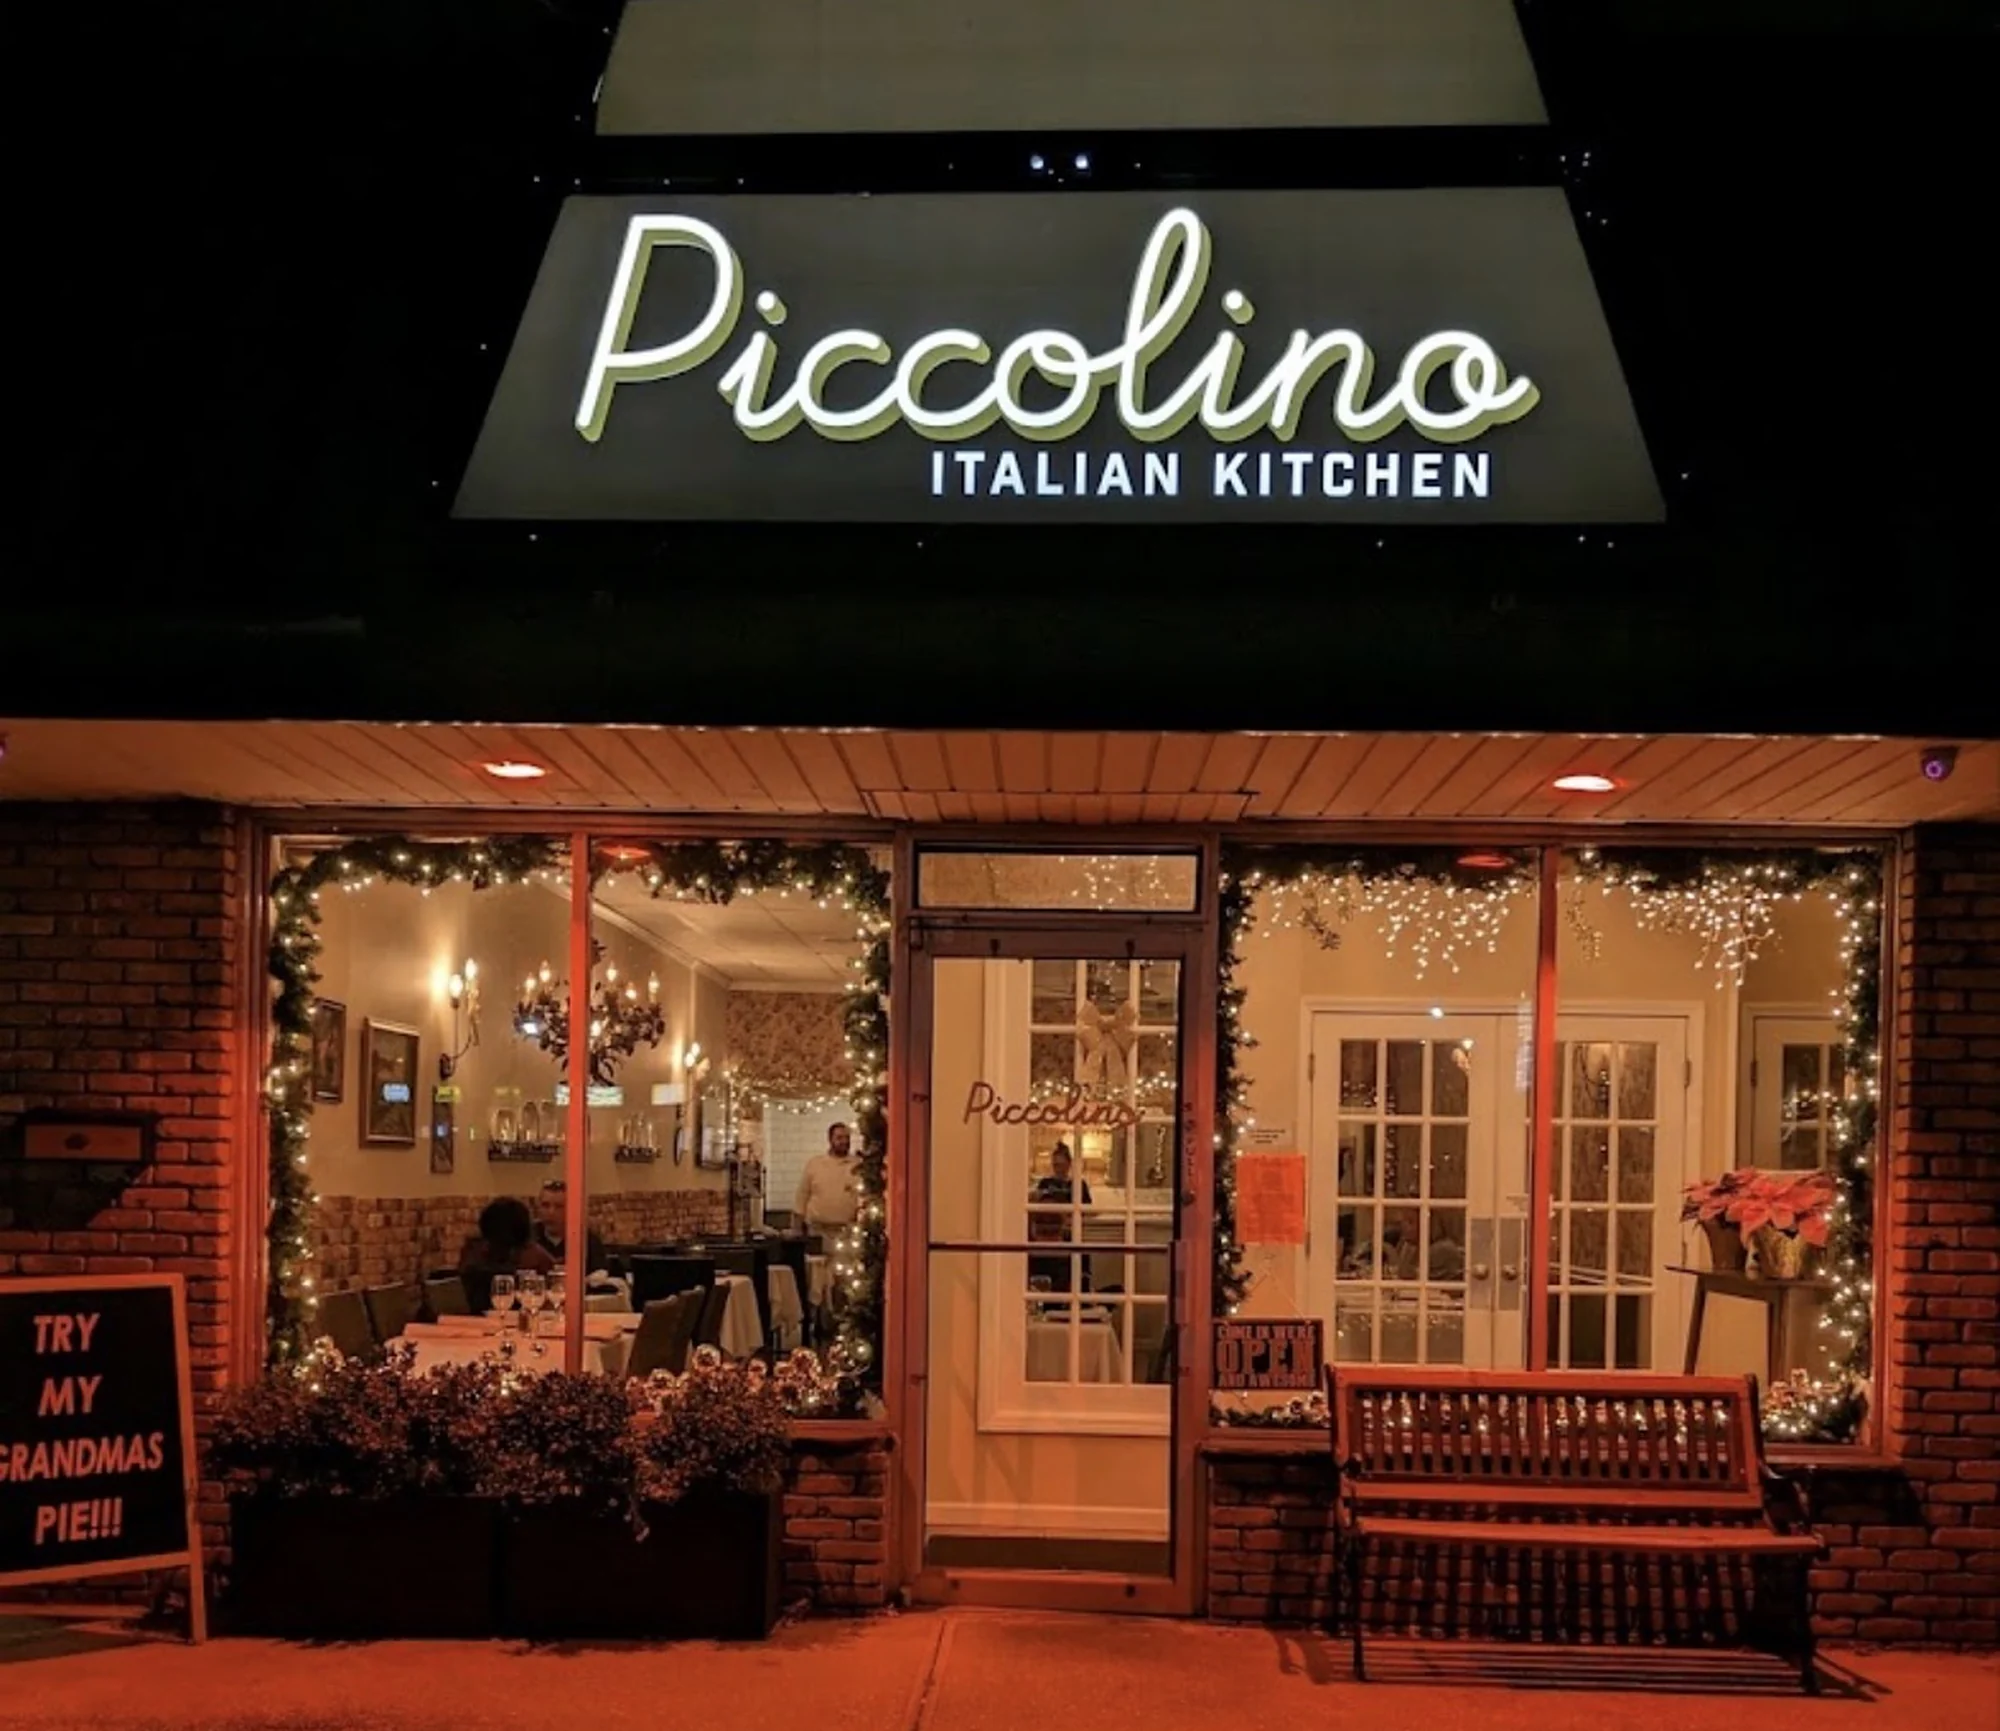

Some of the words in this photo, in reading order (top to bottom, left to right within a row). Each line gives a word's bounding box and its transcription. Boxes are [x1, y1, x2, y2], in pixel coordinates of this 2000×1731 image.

[576, 208, 1539, 442] Piccolino
[932, 451, 1180, 497] ITALIAN
[1213, 452, 1490, 497] KITCHEN
[963, 1081, 1146, 1129] Piccolino
[34, 1313, 100, 1354] TRY
[1217, 1339, 1316, 1374] OPEN
[38, 1376, 102, 1418] MY
[35, 1497, 123, 1545] PIE!!!
